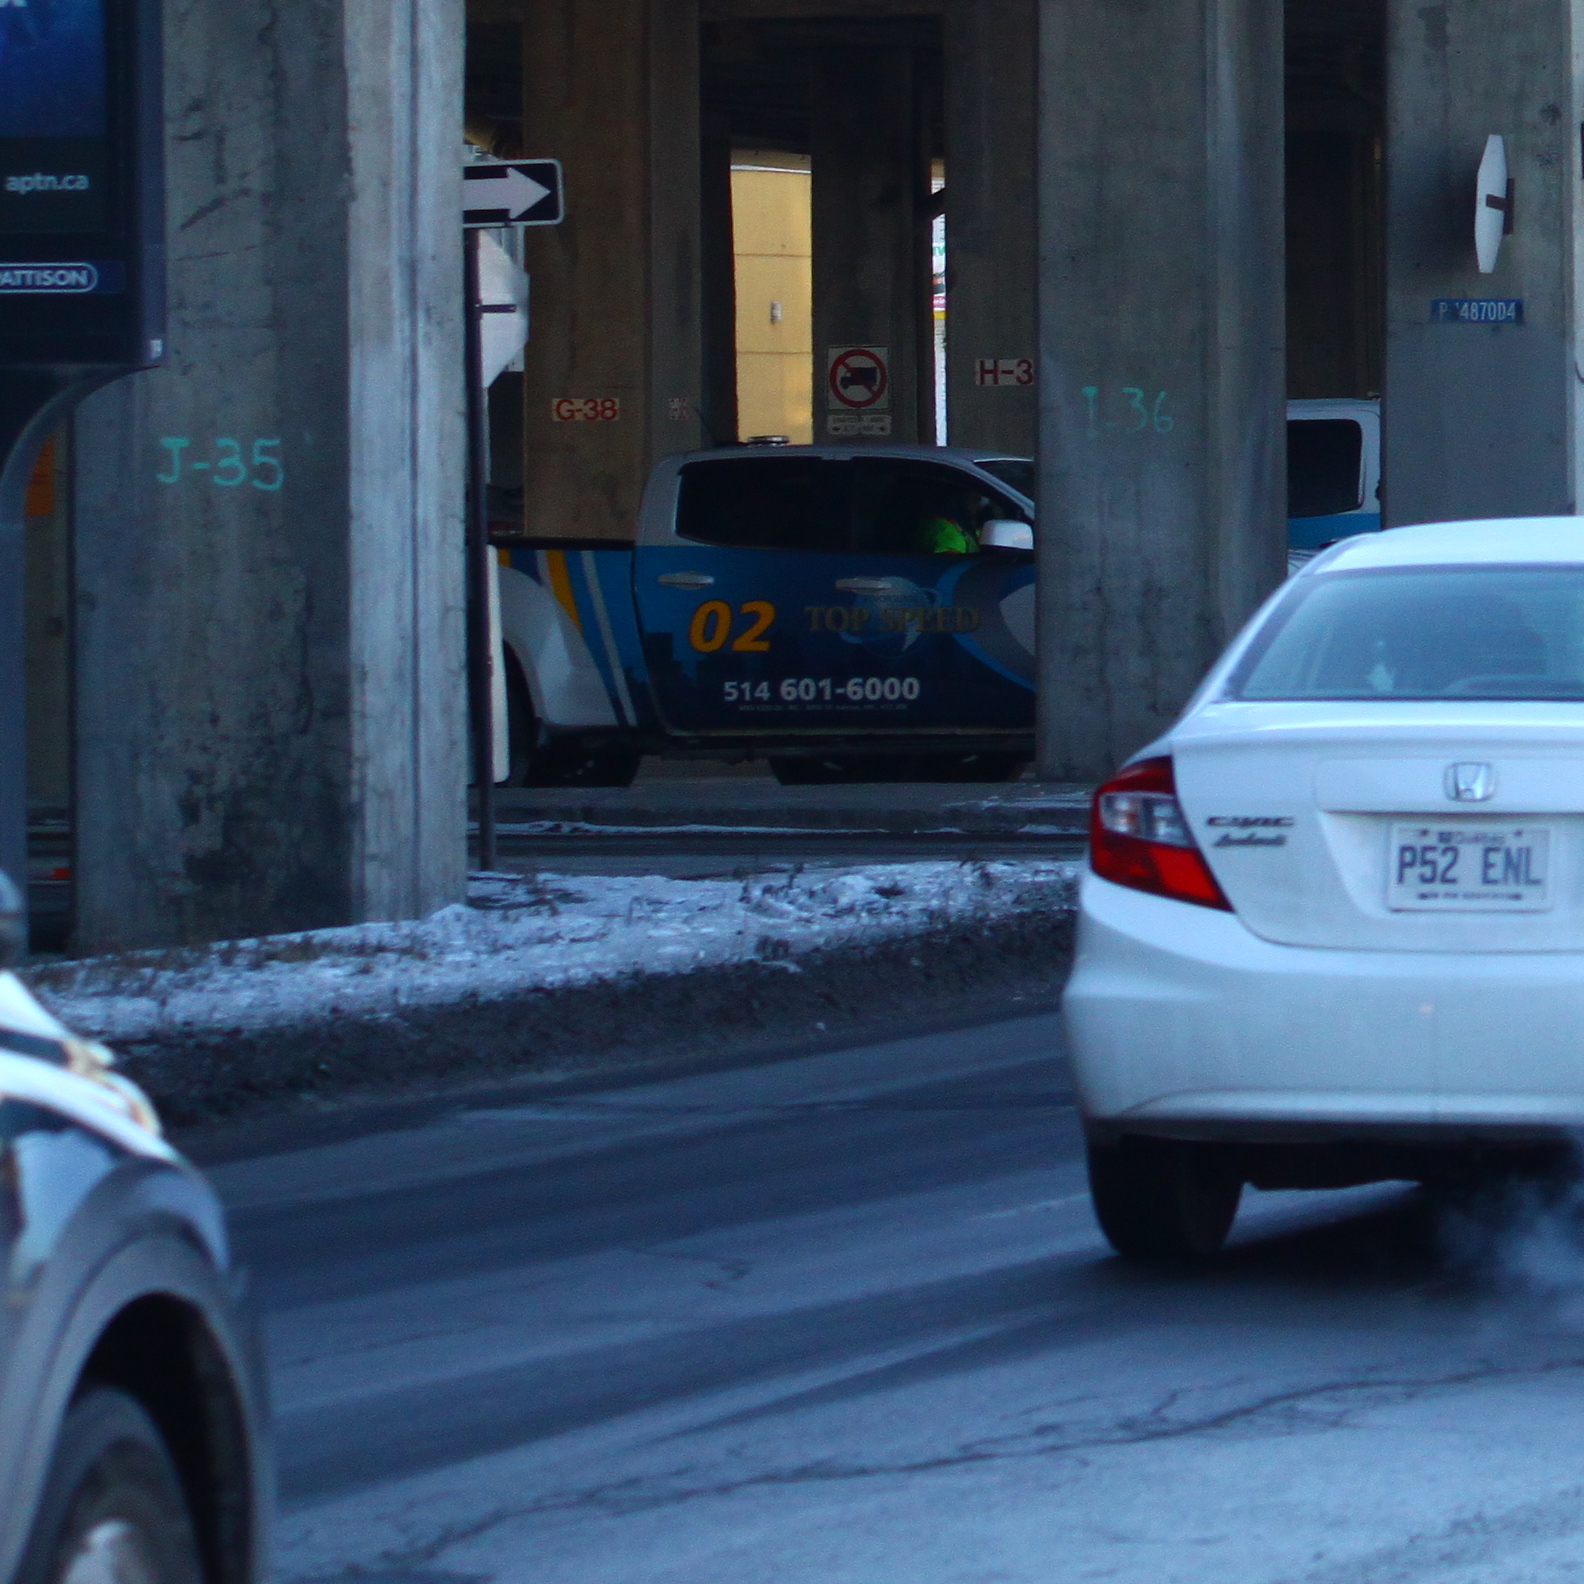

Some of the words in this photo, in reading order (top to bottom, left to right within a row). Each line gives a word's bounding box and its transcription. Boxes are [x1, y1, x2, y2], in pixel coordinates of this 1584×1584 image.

[4, 172, 90, 193] aptn.ca
[555, 399, 619, 421] G-38
[156, 436, 285, 491] J-35
[688, 600, 777, 653] 02
[804, 606, 872, 633] TOP
[879, 606, 982, 633] SPEED
[723, 680, 771, 702] 514
[779, 676, 921, 702] 601-6000
[1397, 845, 1459, 884] P52
[1482, 846, 1542, 884] ENL
